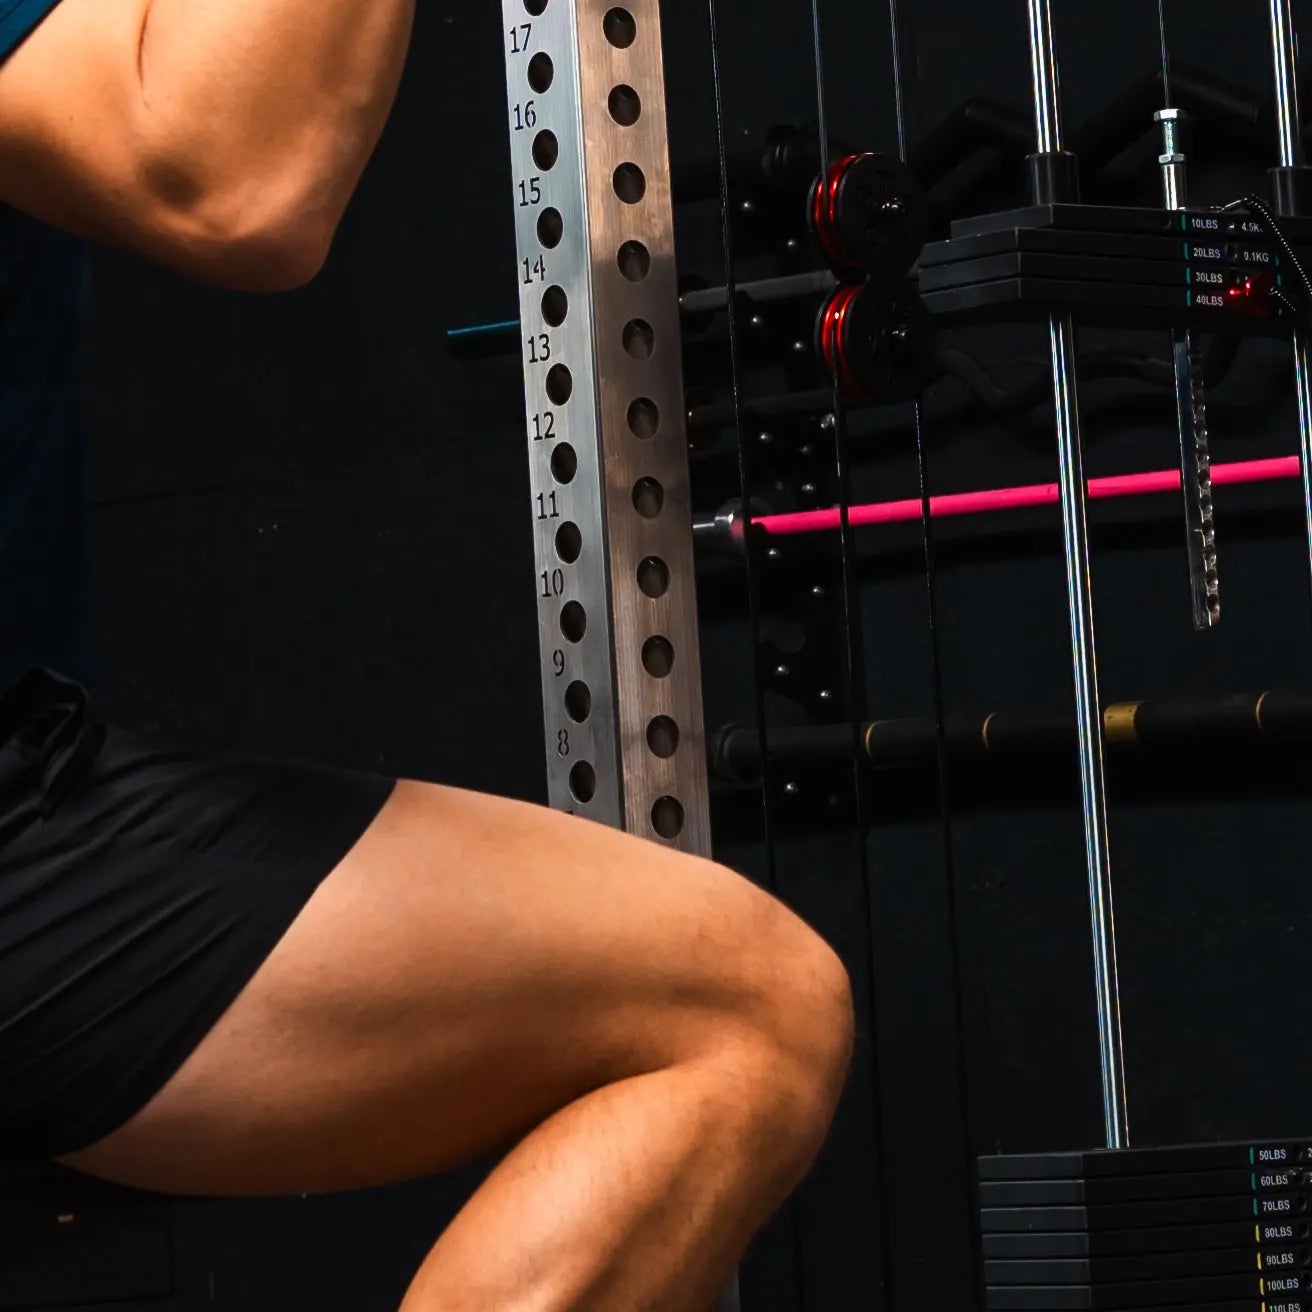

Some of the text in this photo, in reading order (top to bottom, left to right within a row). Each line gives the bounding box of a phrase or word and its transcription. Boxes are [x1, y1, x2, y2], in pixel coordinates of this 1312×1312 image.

[510, 24, 532, 54] 17
[514, 101, 537, 131] 16
[518, 177, 541, 207] 15
[1241, 221, 1264, 232] 4.5K
[1193, 247, 1221, 260] 20LBS
[523, 254, 546, 285] 14
[528, 333, 551, 362] 13
[532, 413, 556, 441] 12
[537, 491, 560, 519] 11
[541, 568, 564, 597] 10
[553, 648, 565, 675] 9
[557, 728, 569, 756] 8
[1259, 1149, 1286, 1161] 50LBS
[1261, 1175, 1288, 1187] 60LBS
[1262, 1200, 1290, 1212] 70LBS
[1264, 1226, 1292, 1239] 80LBS
[1266, 1253, 1294, 1265] 90LBS
